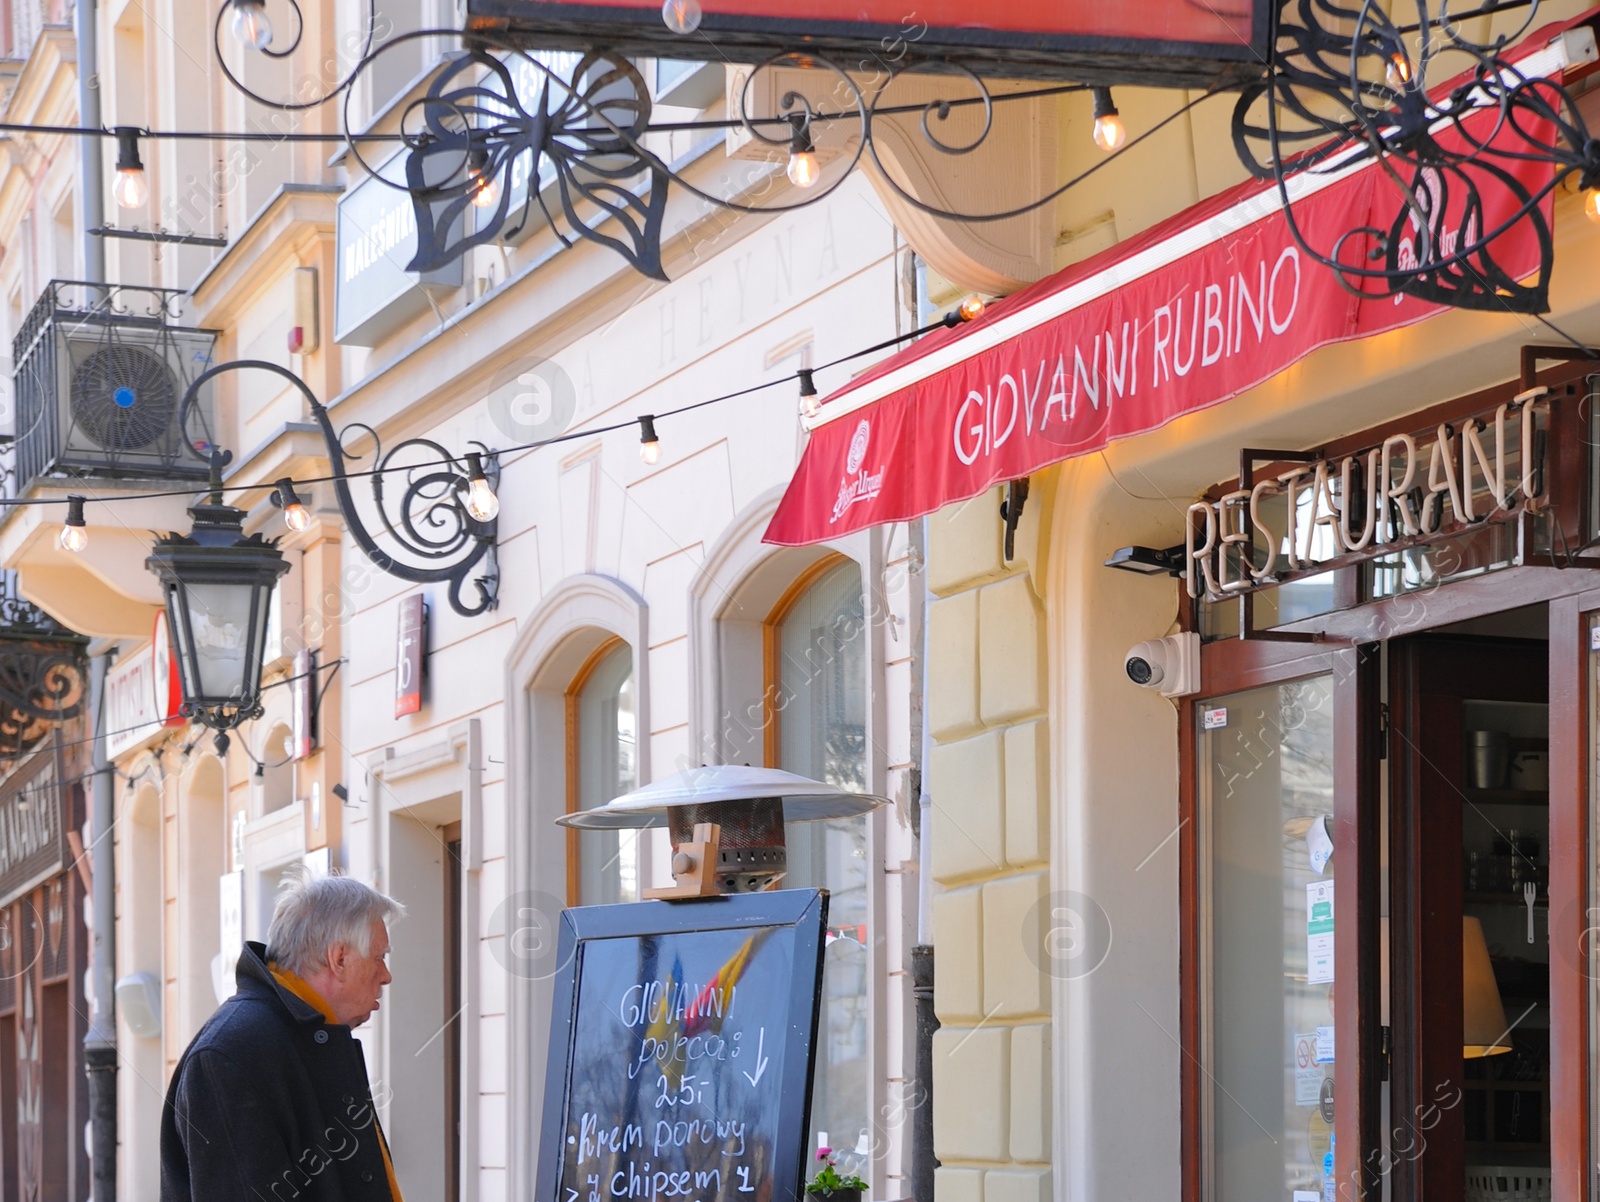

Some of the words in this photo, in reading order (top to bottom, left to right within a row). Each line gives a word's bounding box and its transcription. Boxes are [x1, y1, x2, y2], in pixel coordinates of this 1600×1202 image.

[954, 317, 1139, 466] GIOVANNI
[1153, 246, 1300, 389] RUBINO
[1186, 386, 1549, 599] RESTAURANT
[620, 980, 737, 1028] GIOVANNI
[577, 1112, 643, 1165] Krem
[653, 1119, 746, 1157] porowy
